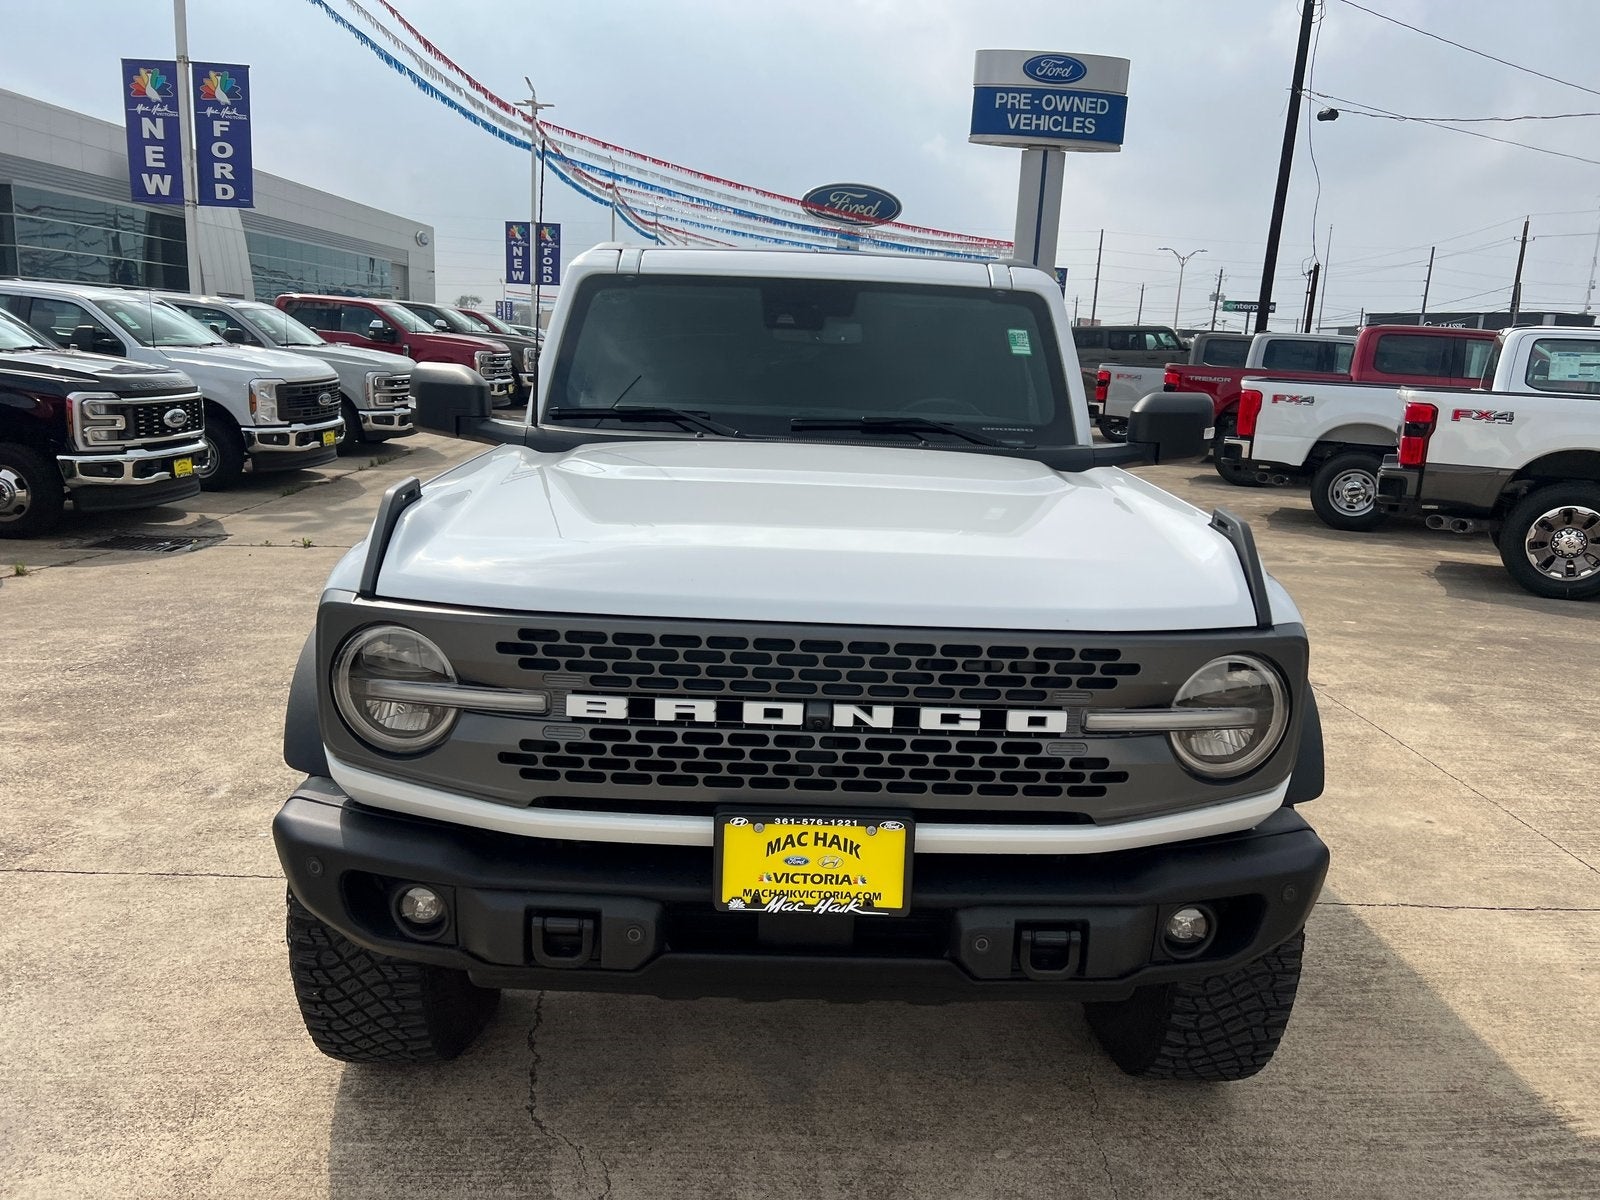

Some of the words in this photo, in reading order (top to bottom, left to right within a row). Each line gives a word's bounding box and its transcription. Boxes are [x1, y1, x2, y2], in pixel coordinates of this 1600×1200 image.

[1035, 58, 1074, 78] Ford
[995, 92, 1109, 115] PRE-OWNED
[1007, 113, 1096, 134] VEHICLES
[141, 117, 172, 196] NEW
[211, 120, 235, 200] FORD
[512, 246, 524, 281] NEW
[542, 248, 553, 283] FORD
[1272, 394, 1314, 403] FX4
[1450, 408, 1514, 422] FX4
[566, 694, 1068, 732] BRONCO
[774, 817, 858, 827] 361-576-1221
[766, 831, 808, 858] MAC
[813, 831, 862, 859] HAIK
[773, 872, 853, 886] VICTORIA
[742, 888, 882, 901] MACHAIKVICTORIA.COM
[762, 895, 811, 914] Mac
[812, 896, 868, 915] Haik
